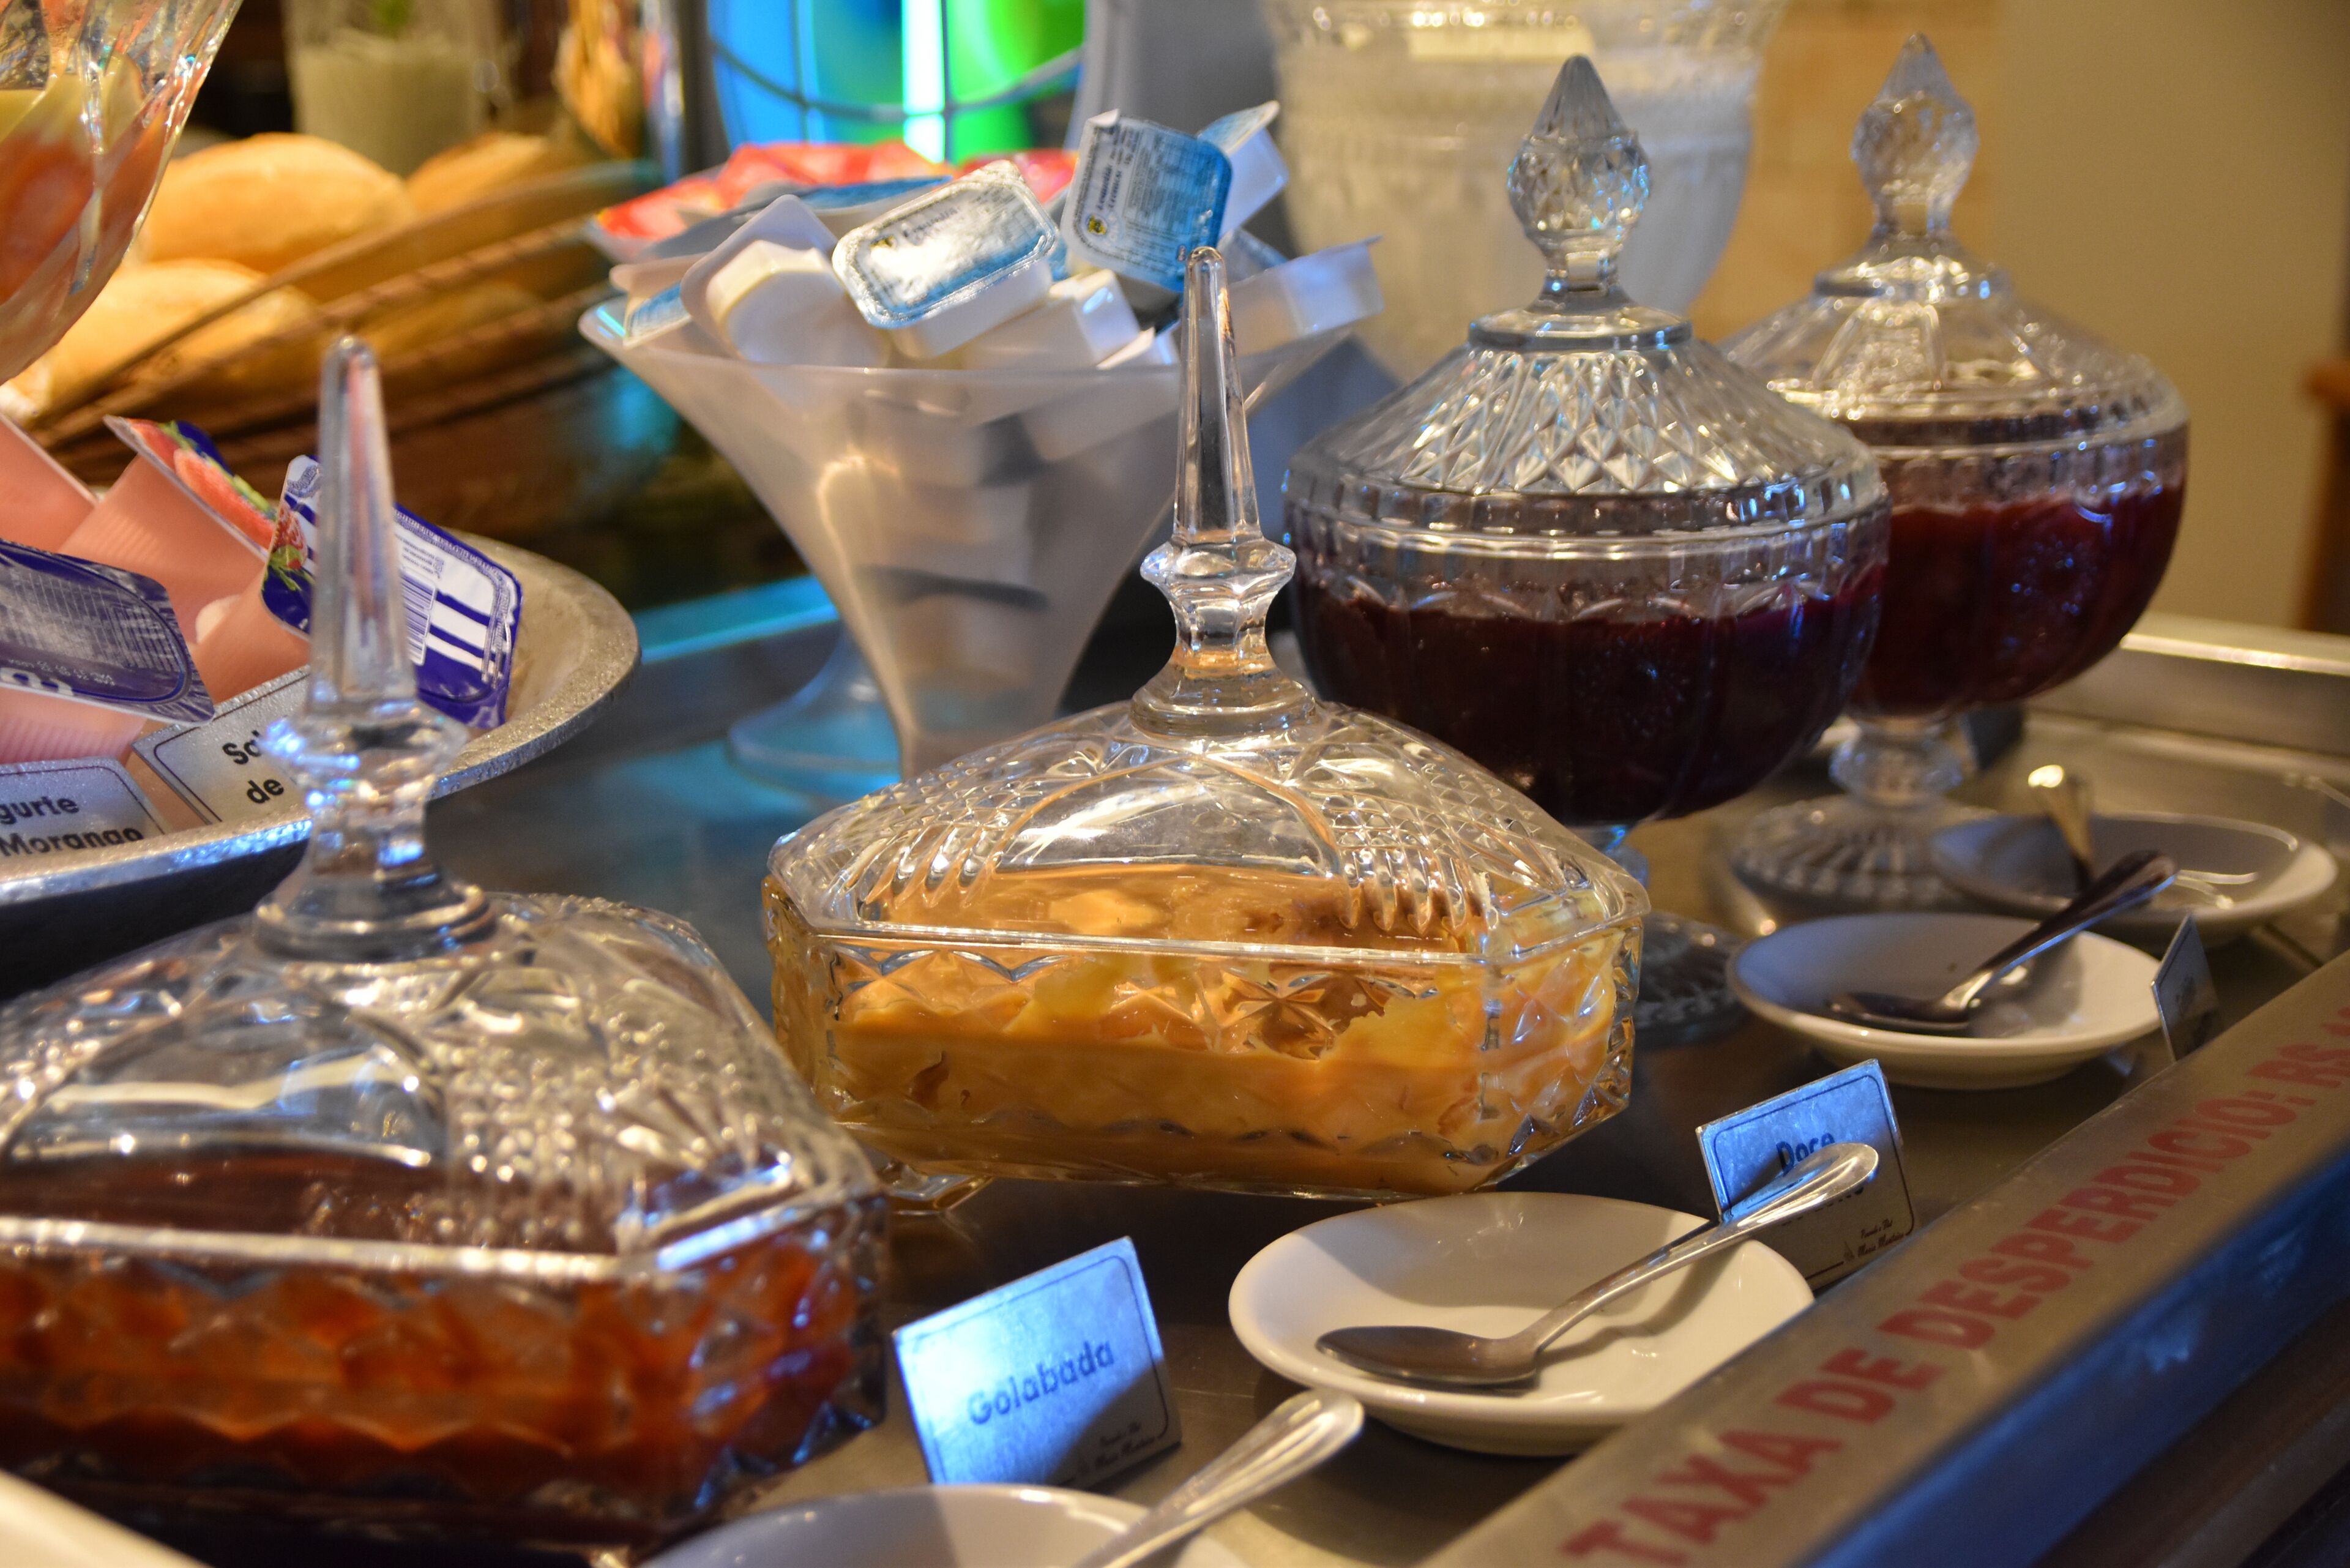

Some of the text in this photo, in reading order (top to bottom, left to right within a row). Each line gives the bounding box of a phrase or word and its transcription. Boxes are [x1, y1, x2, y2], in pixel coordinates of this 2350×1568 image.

[247, 779, 285, 804] de
[1558, 1428, 1844, 1568] TAXA
[1774, 1348, 1950, 1424] DE
